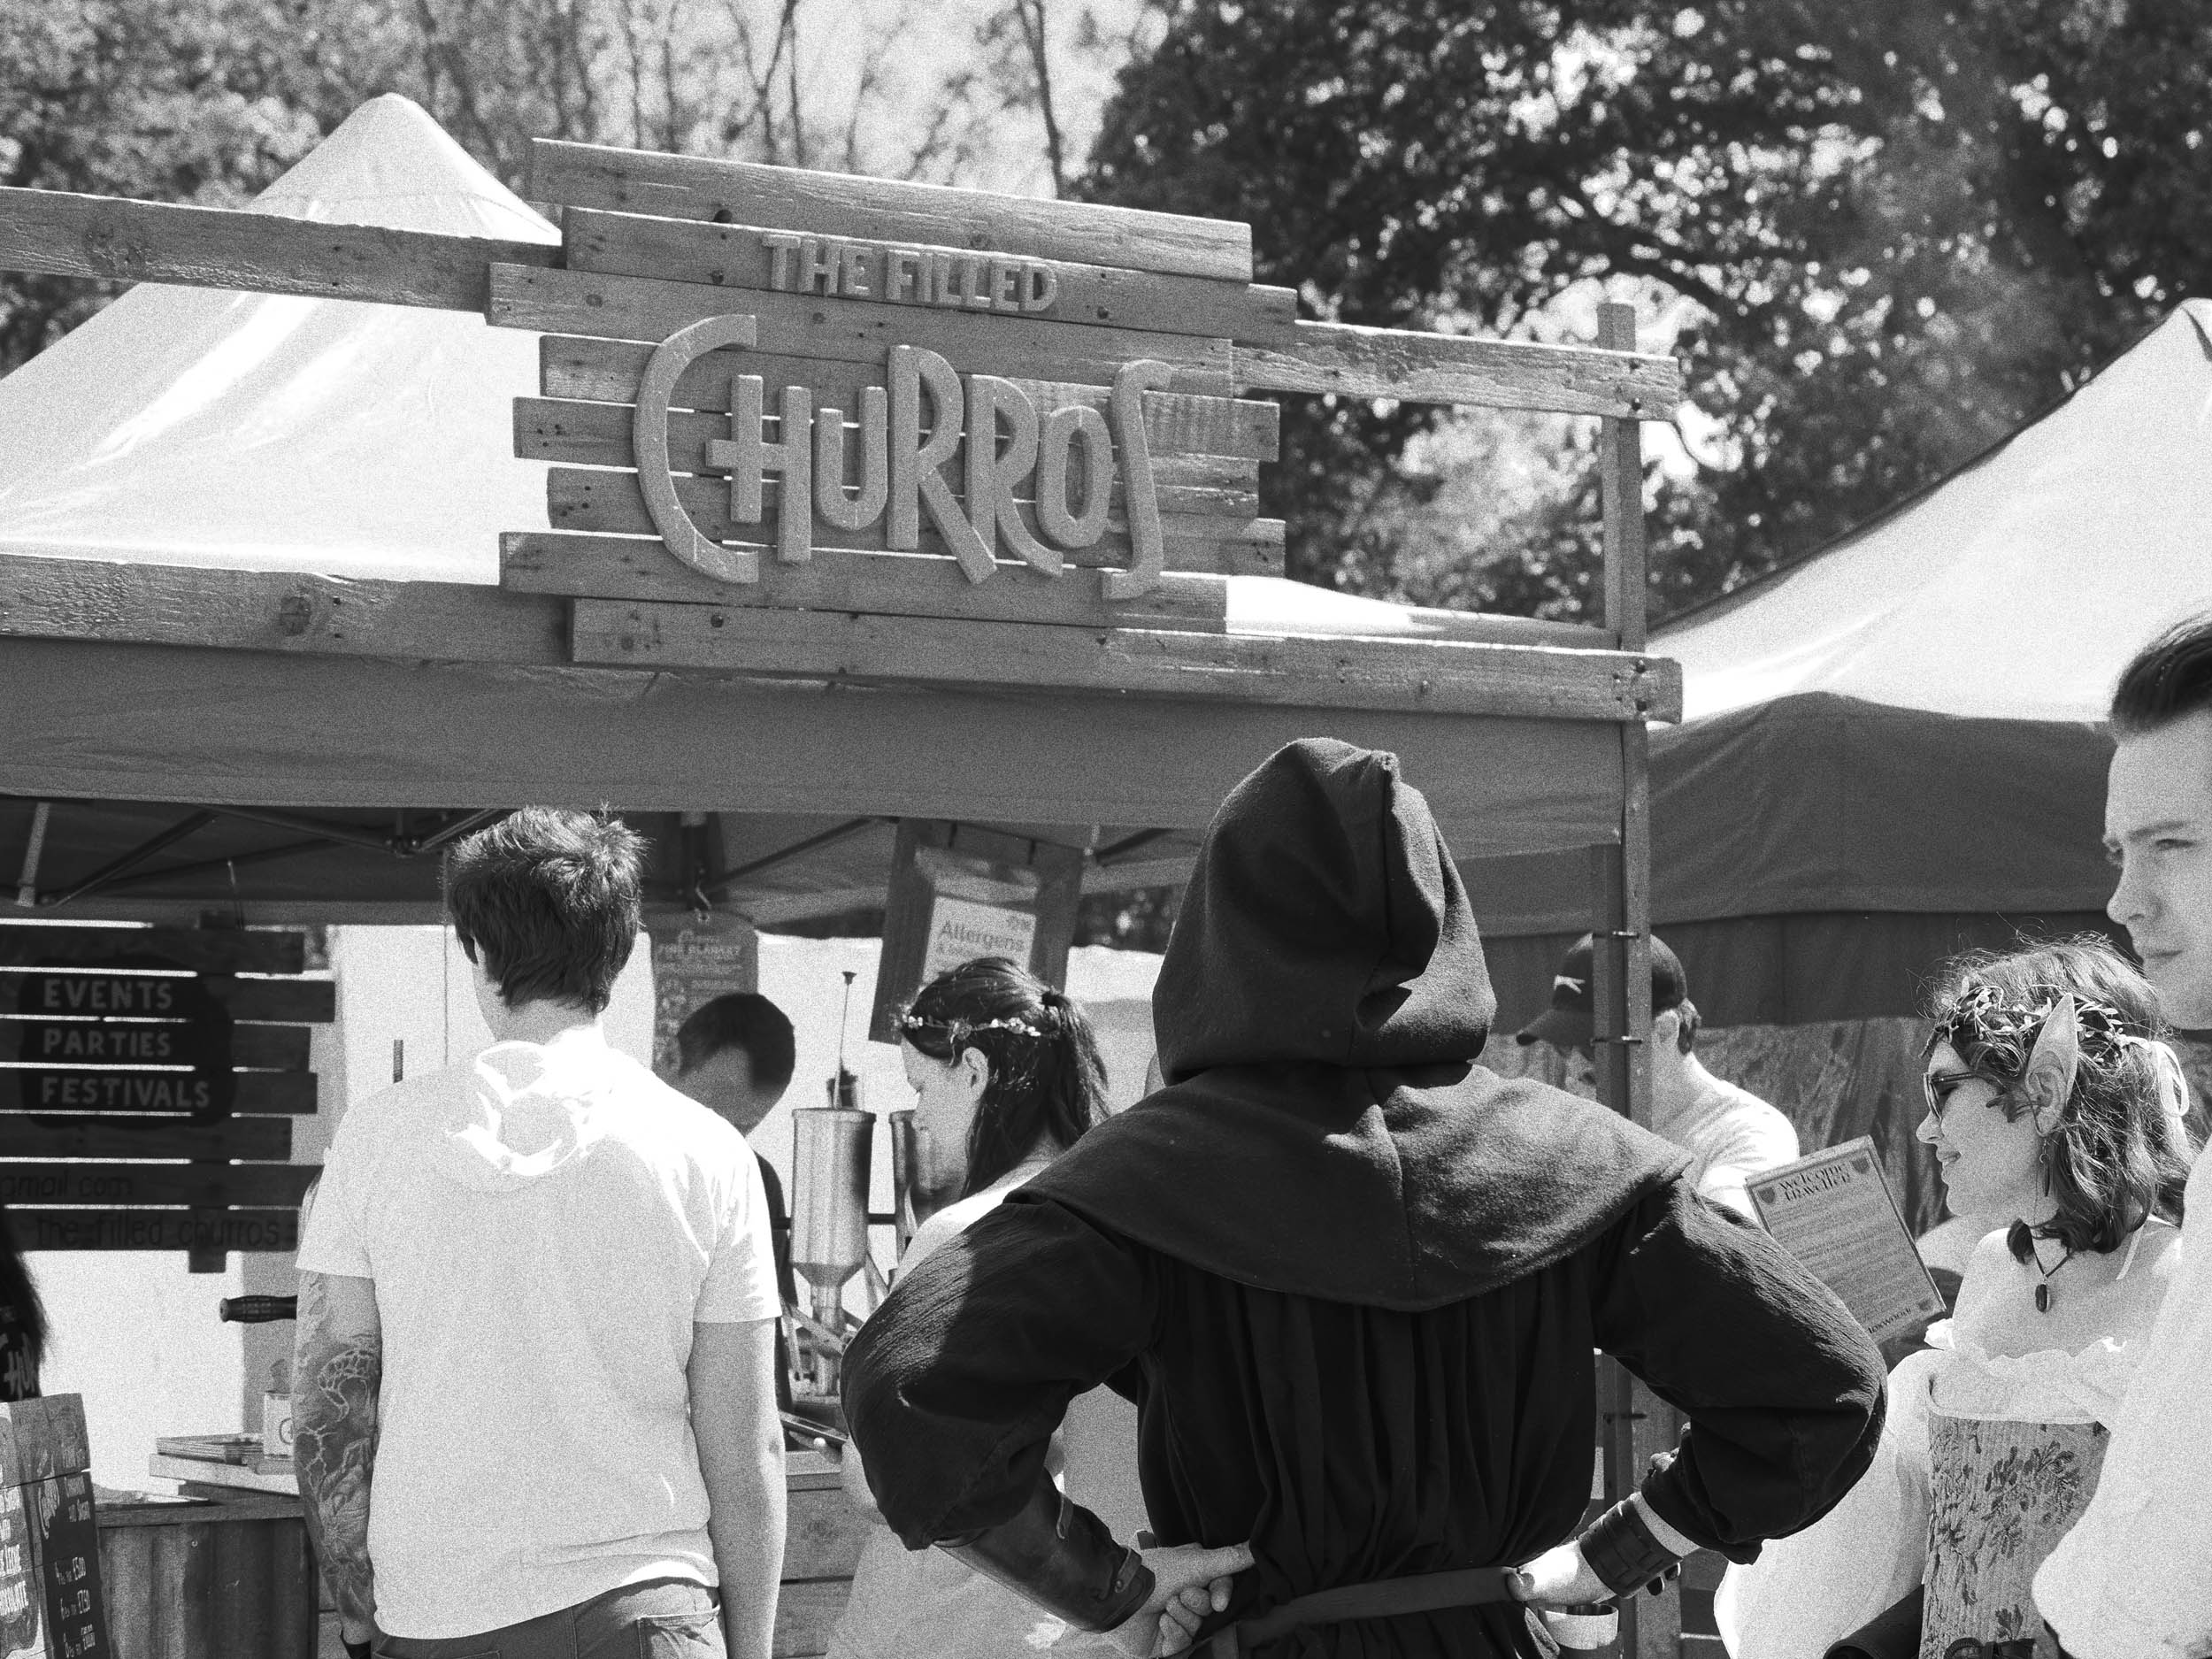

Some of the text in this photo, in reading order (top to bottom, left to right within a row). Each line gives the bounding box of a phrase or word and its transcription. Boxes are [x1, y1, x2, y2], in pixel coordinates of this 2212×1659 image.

[762, 234, 1059, 311] THE FILLED
[633, 314, 1172, 600] CHURROS
[939, 920, 1025, 953] Allergens
[42, 978, 173, 1010] EVENTS
[42, 1028, 172, 1057] PARTIES
[41, 1076, 211, 1109] FESTIVALS
